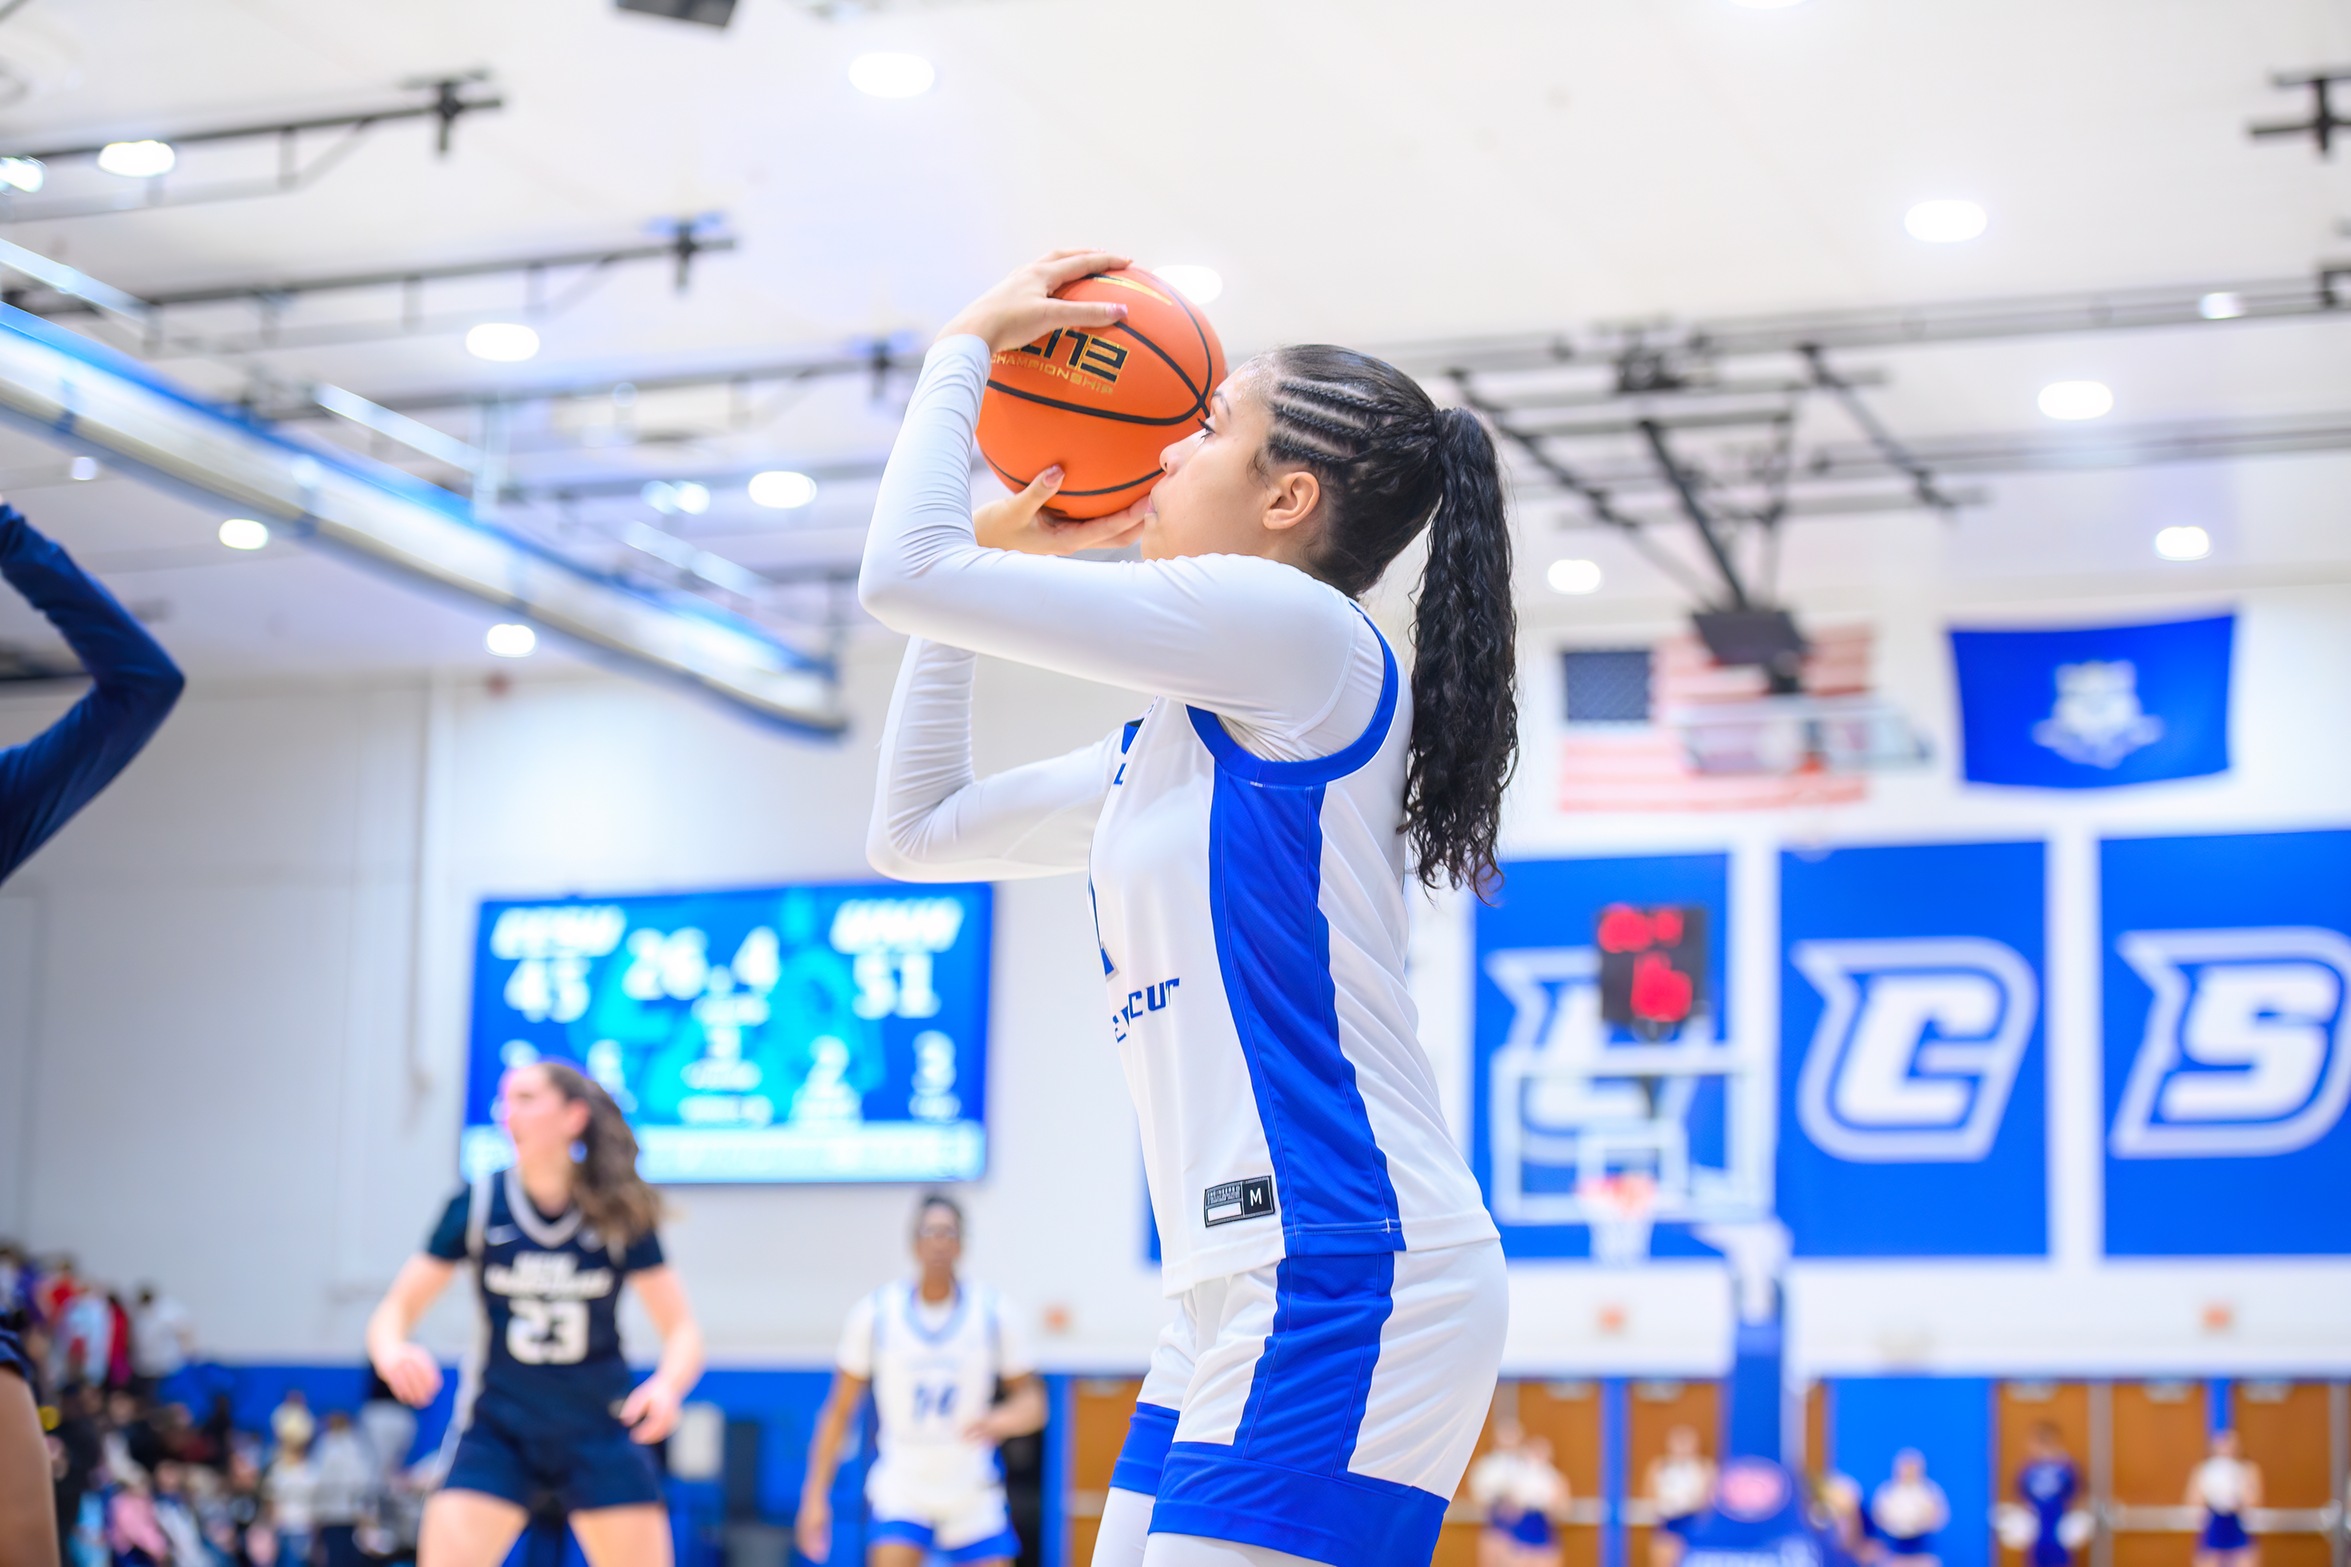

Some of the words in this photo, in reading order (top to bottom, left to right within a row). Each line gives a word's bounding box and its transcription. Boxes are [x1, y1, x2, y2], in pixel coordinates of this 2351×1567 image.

[1003, 327, 1129, 384] LITE
[505, 957, 591, 1022] 45
[853, 950, 941, 1019] 51
[1791, 934, 2040, 1163] C
[2112, 925, 2351, 1160] S
[1249, 1187, 1263, 1207] M
[506, 1297, 589, 1365] 23
